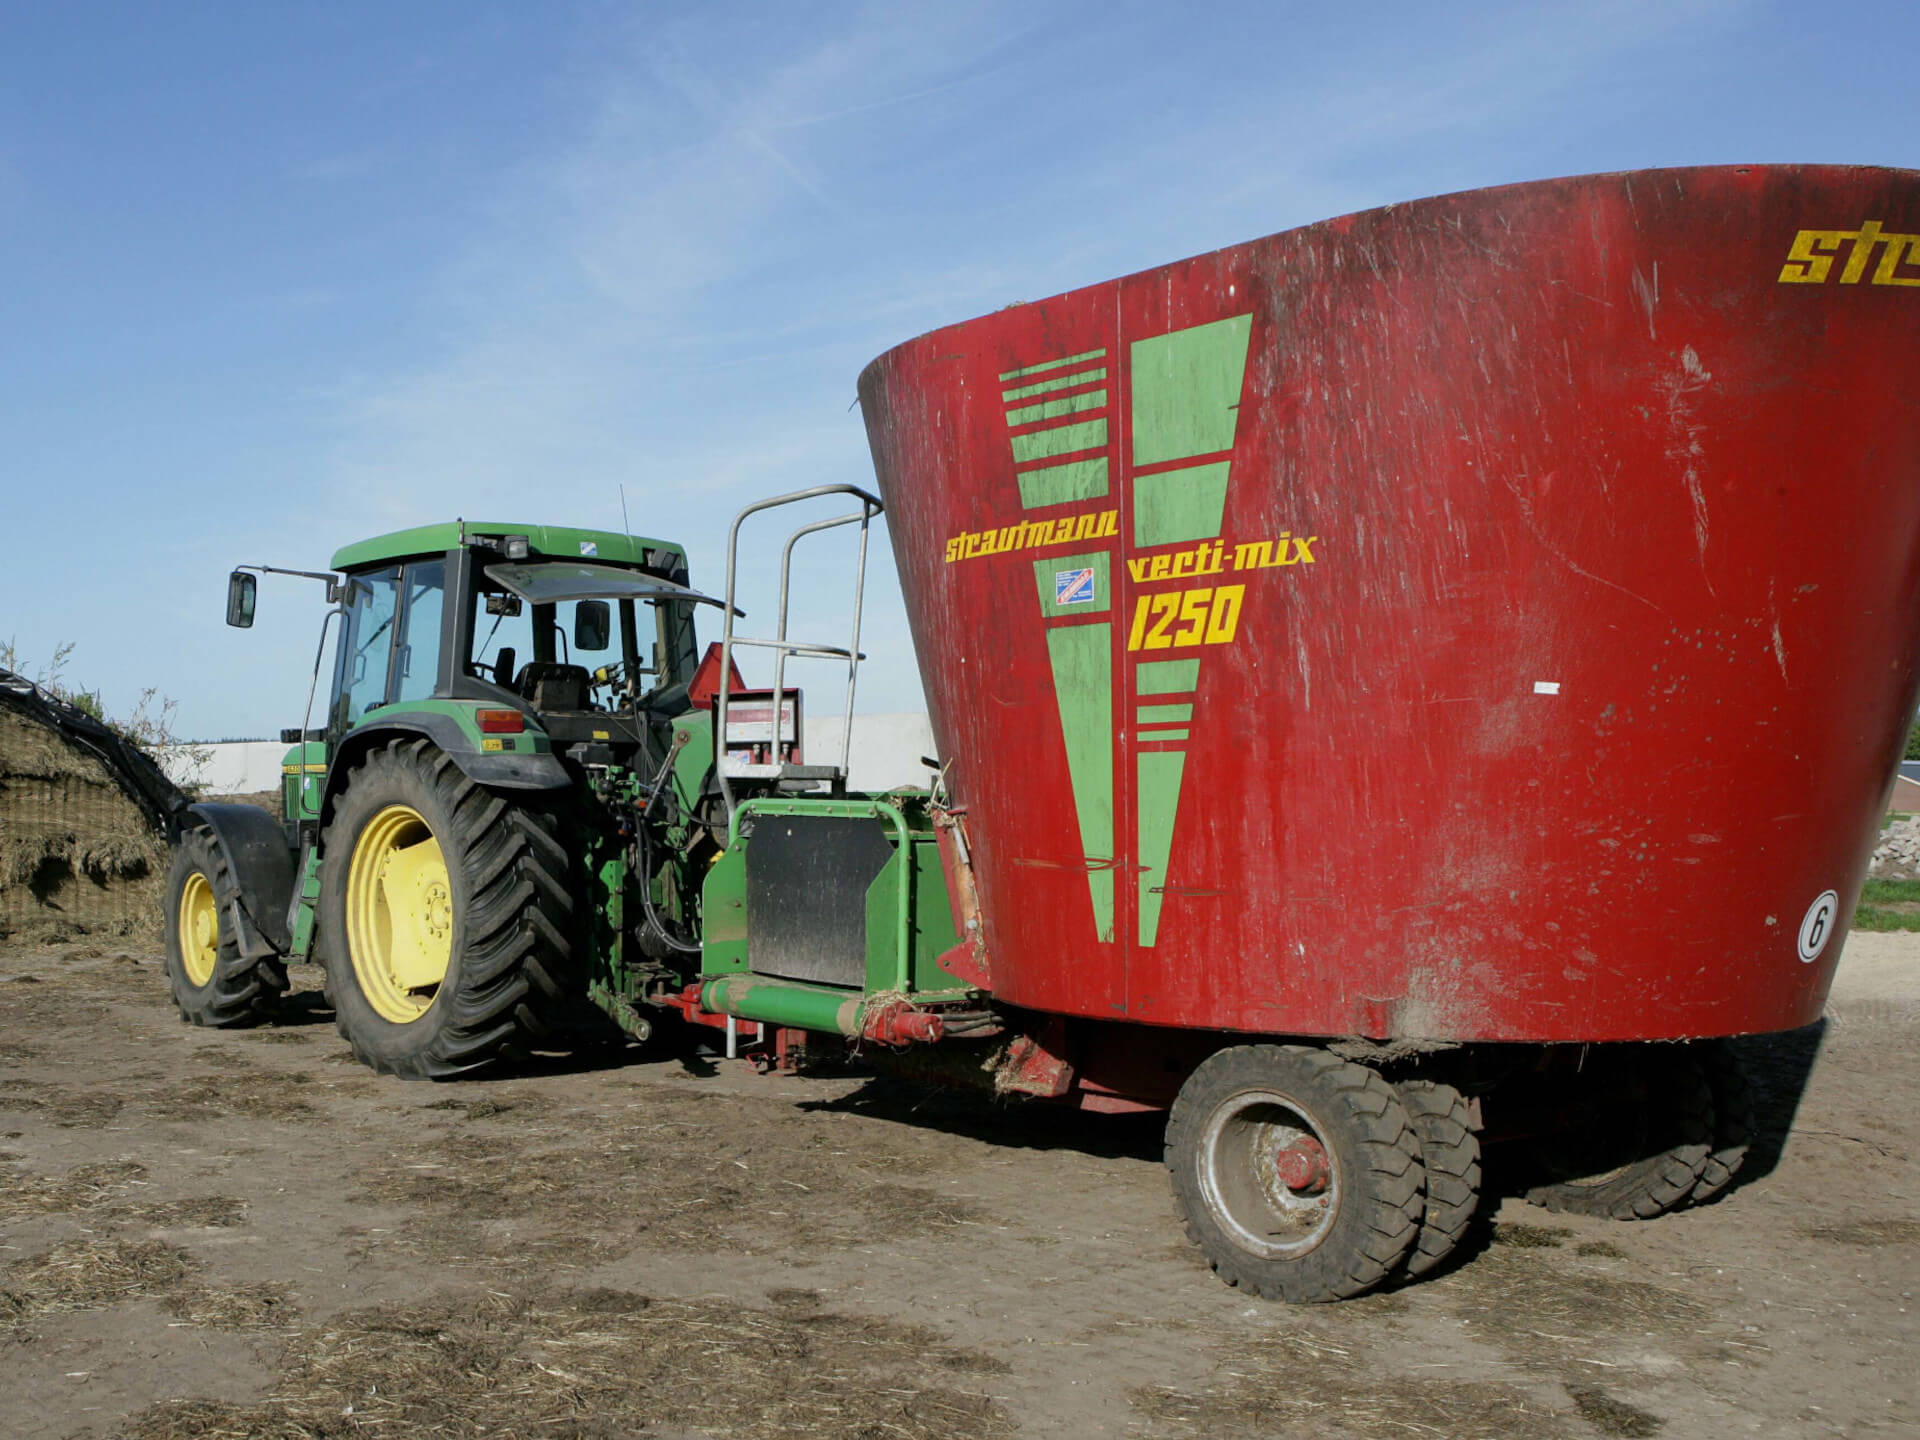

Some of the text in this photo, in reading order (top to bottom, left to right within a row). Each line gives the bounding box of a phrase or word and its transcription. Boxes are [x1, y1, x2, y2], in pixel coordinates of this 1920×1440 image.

[945, 510, 1119, 563] strautmann
[1127, 531, 1318, 583] verti-mix
[1127, 584, 1246, 652] 1250
[1808, 905, 1829, 949] 6
